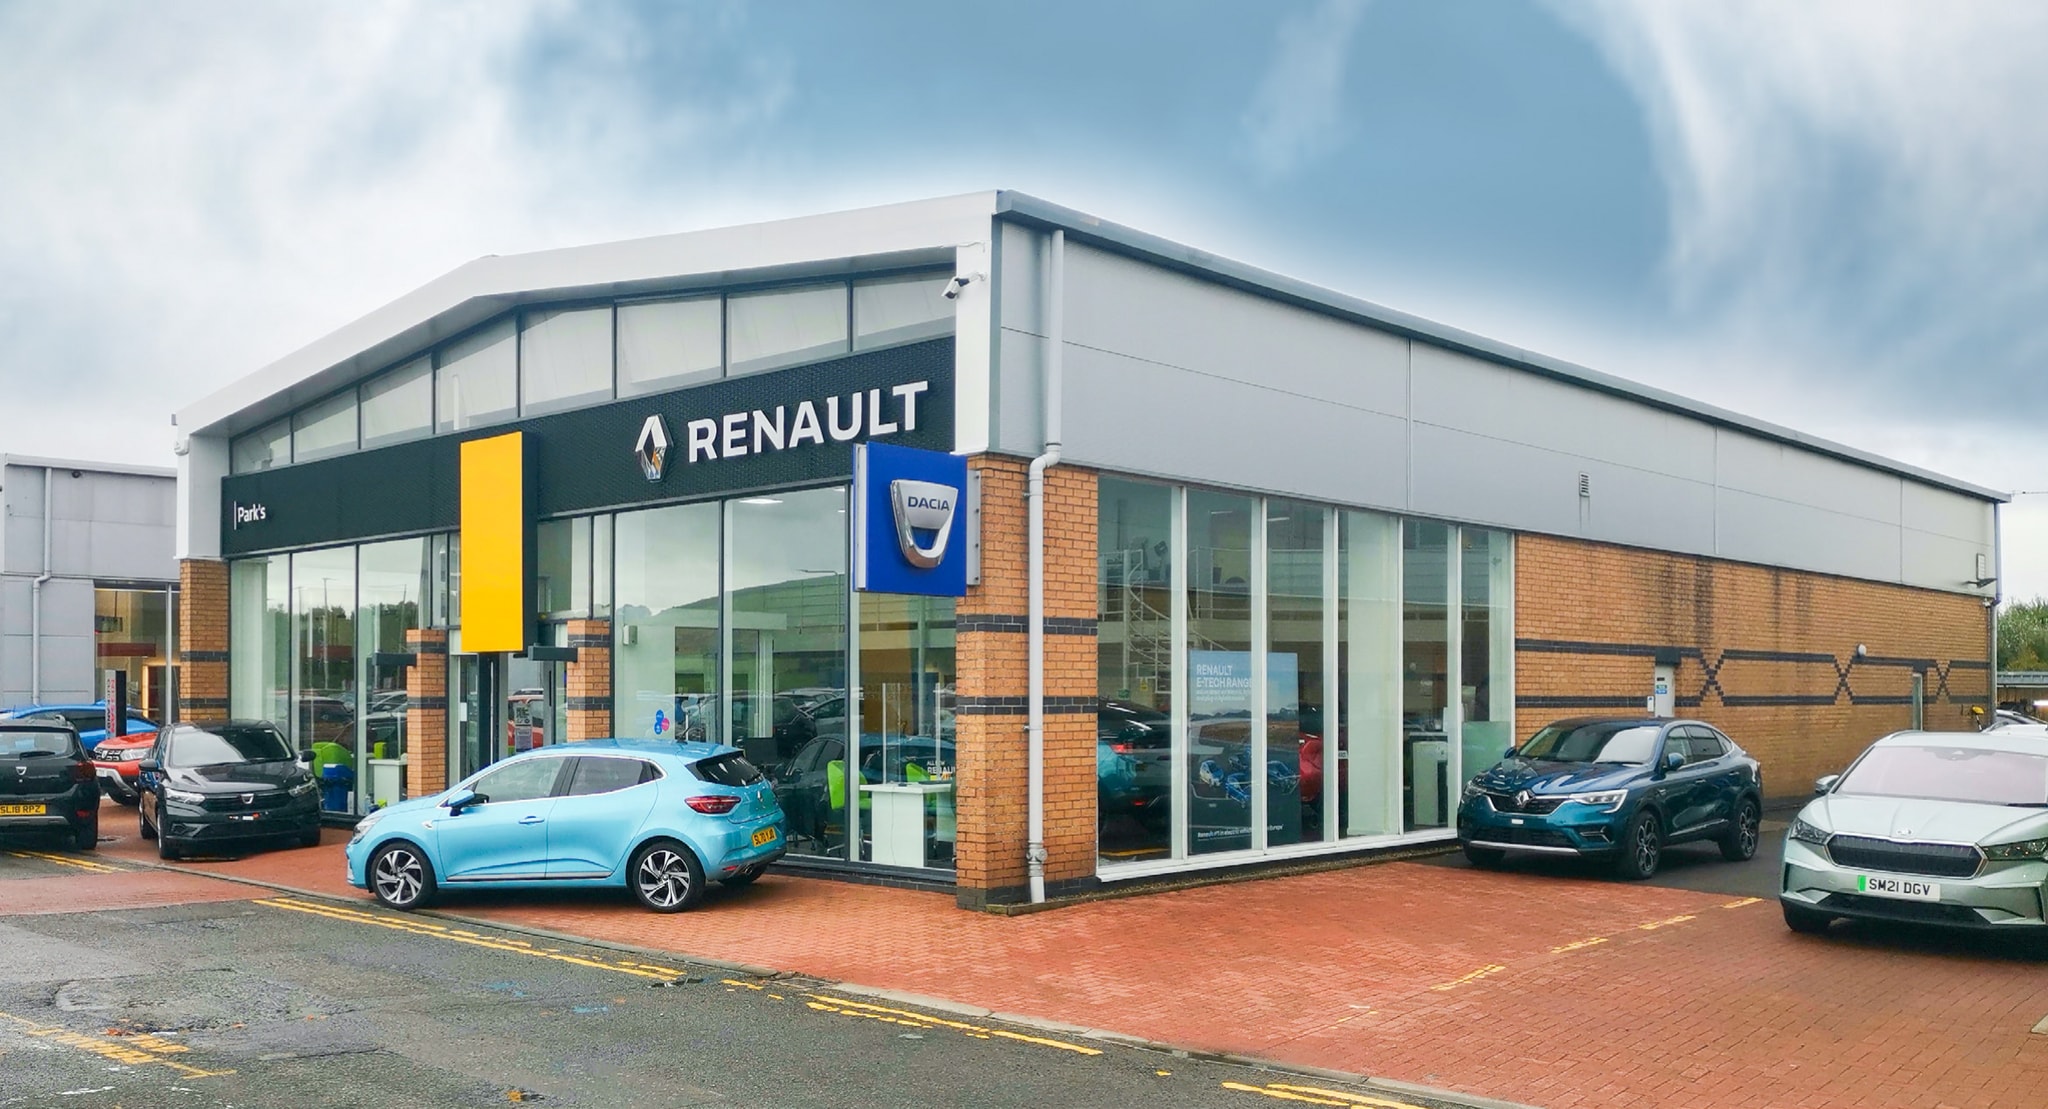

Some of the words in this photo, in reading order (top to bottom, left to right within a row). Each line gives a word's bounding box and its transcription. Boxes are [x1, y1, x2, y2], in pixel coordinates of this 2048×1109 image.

[688, 380, 928, 463] RENAULT
[907, 496, 949, 511] DACIA
[237, 503, 266, 523] Park's
[1196, 664, 1232, 676] RENAULT
[1196, 677, 1225, 688] E-TECH
[0, 805, 21, 814] SL18
[23, 805, 42, 813] RPZ
[1869, 878, 1900, 892] SM21
[1903, 882, 1931, 896] DGV
